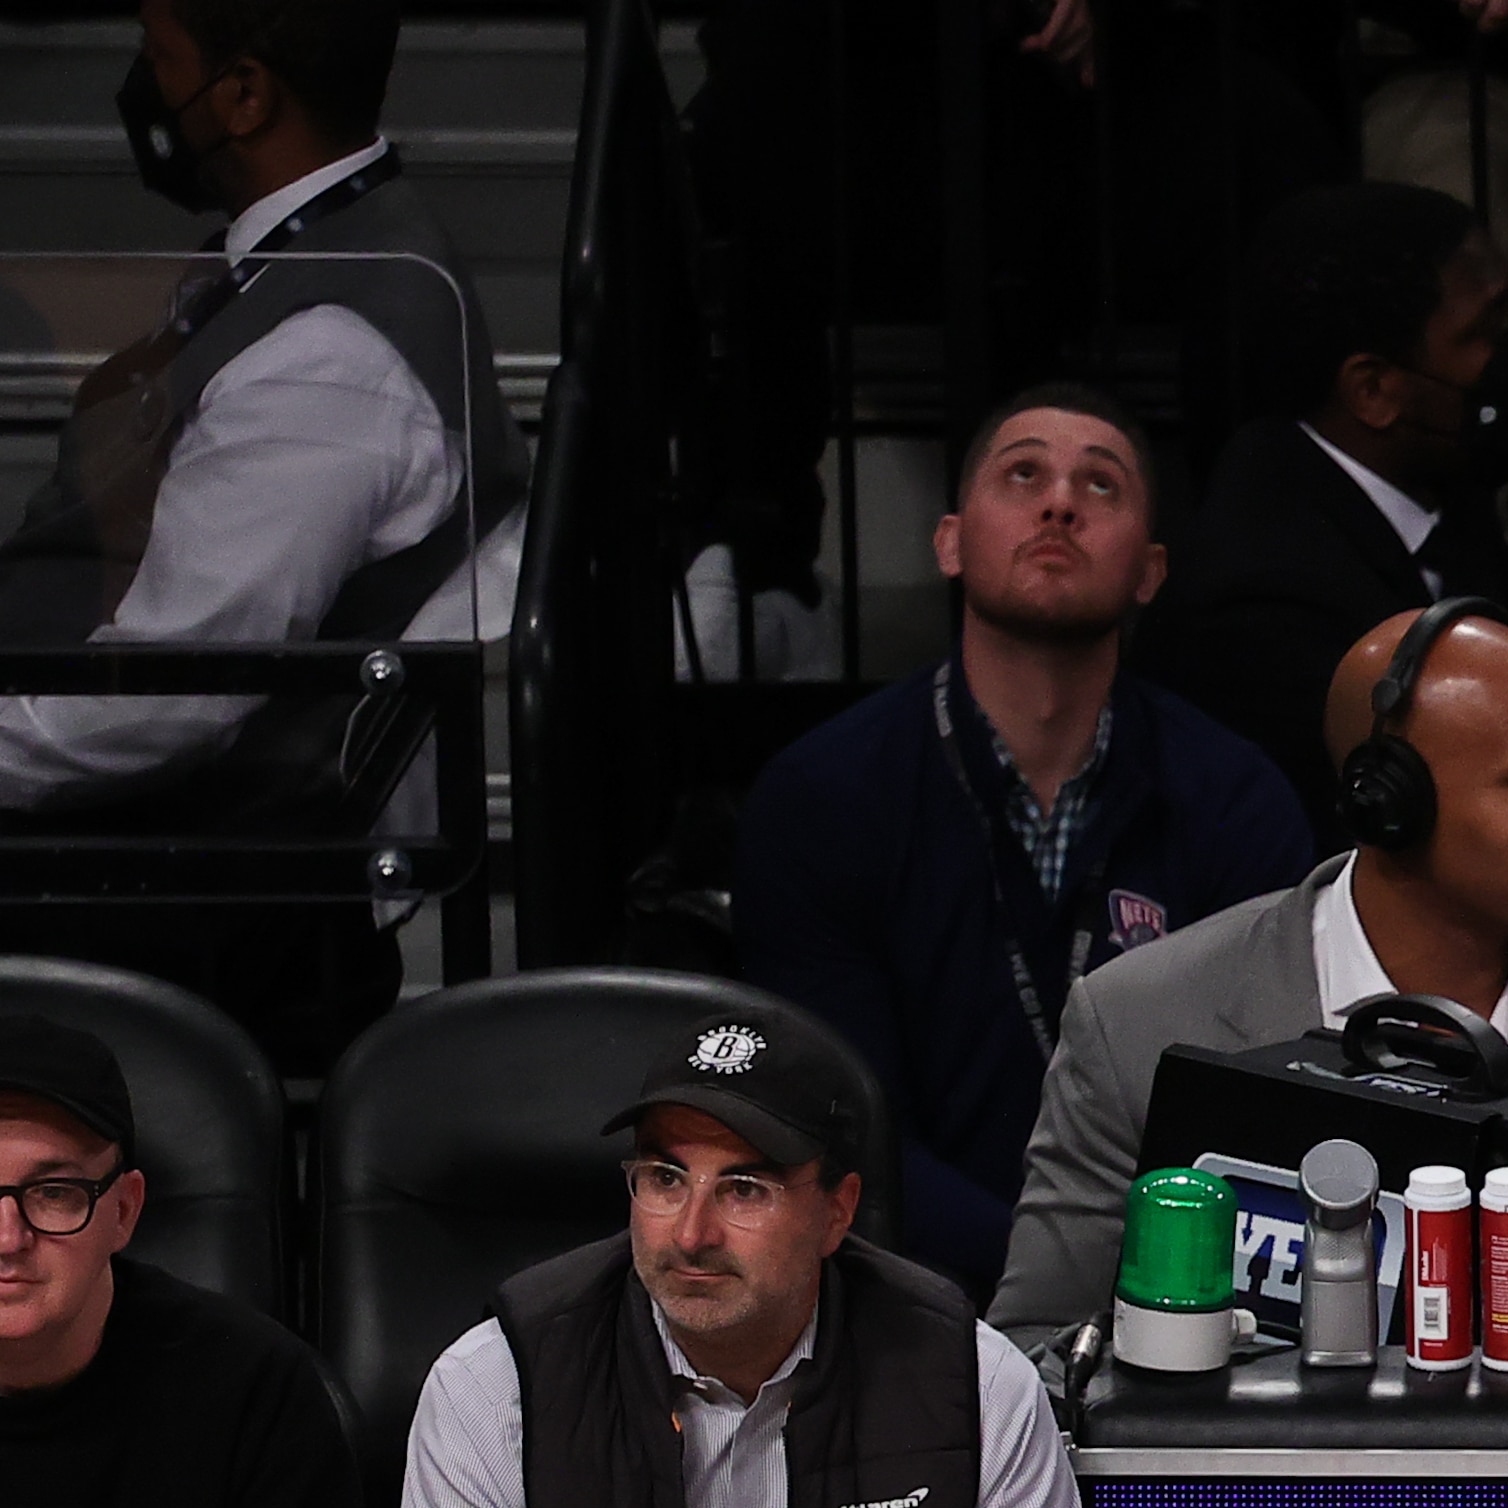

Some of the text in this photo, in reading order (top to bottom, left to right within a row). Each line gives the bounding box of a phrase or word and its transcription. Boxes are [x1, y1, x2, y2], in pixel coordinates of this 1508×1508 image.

[696, 1024, 767, 1049] BROOKLYN
[713, 1035, 739, 1059] B
[687, 1055, 754, 1075] NEW YORK
